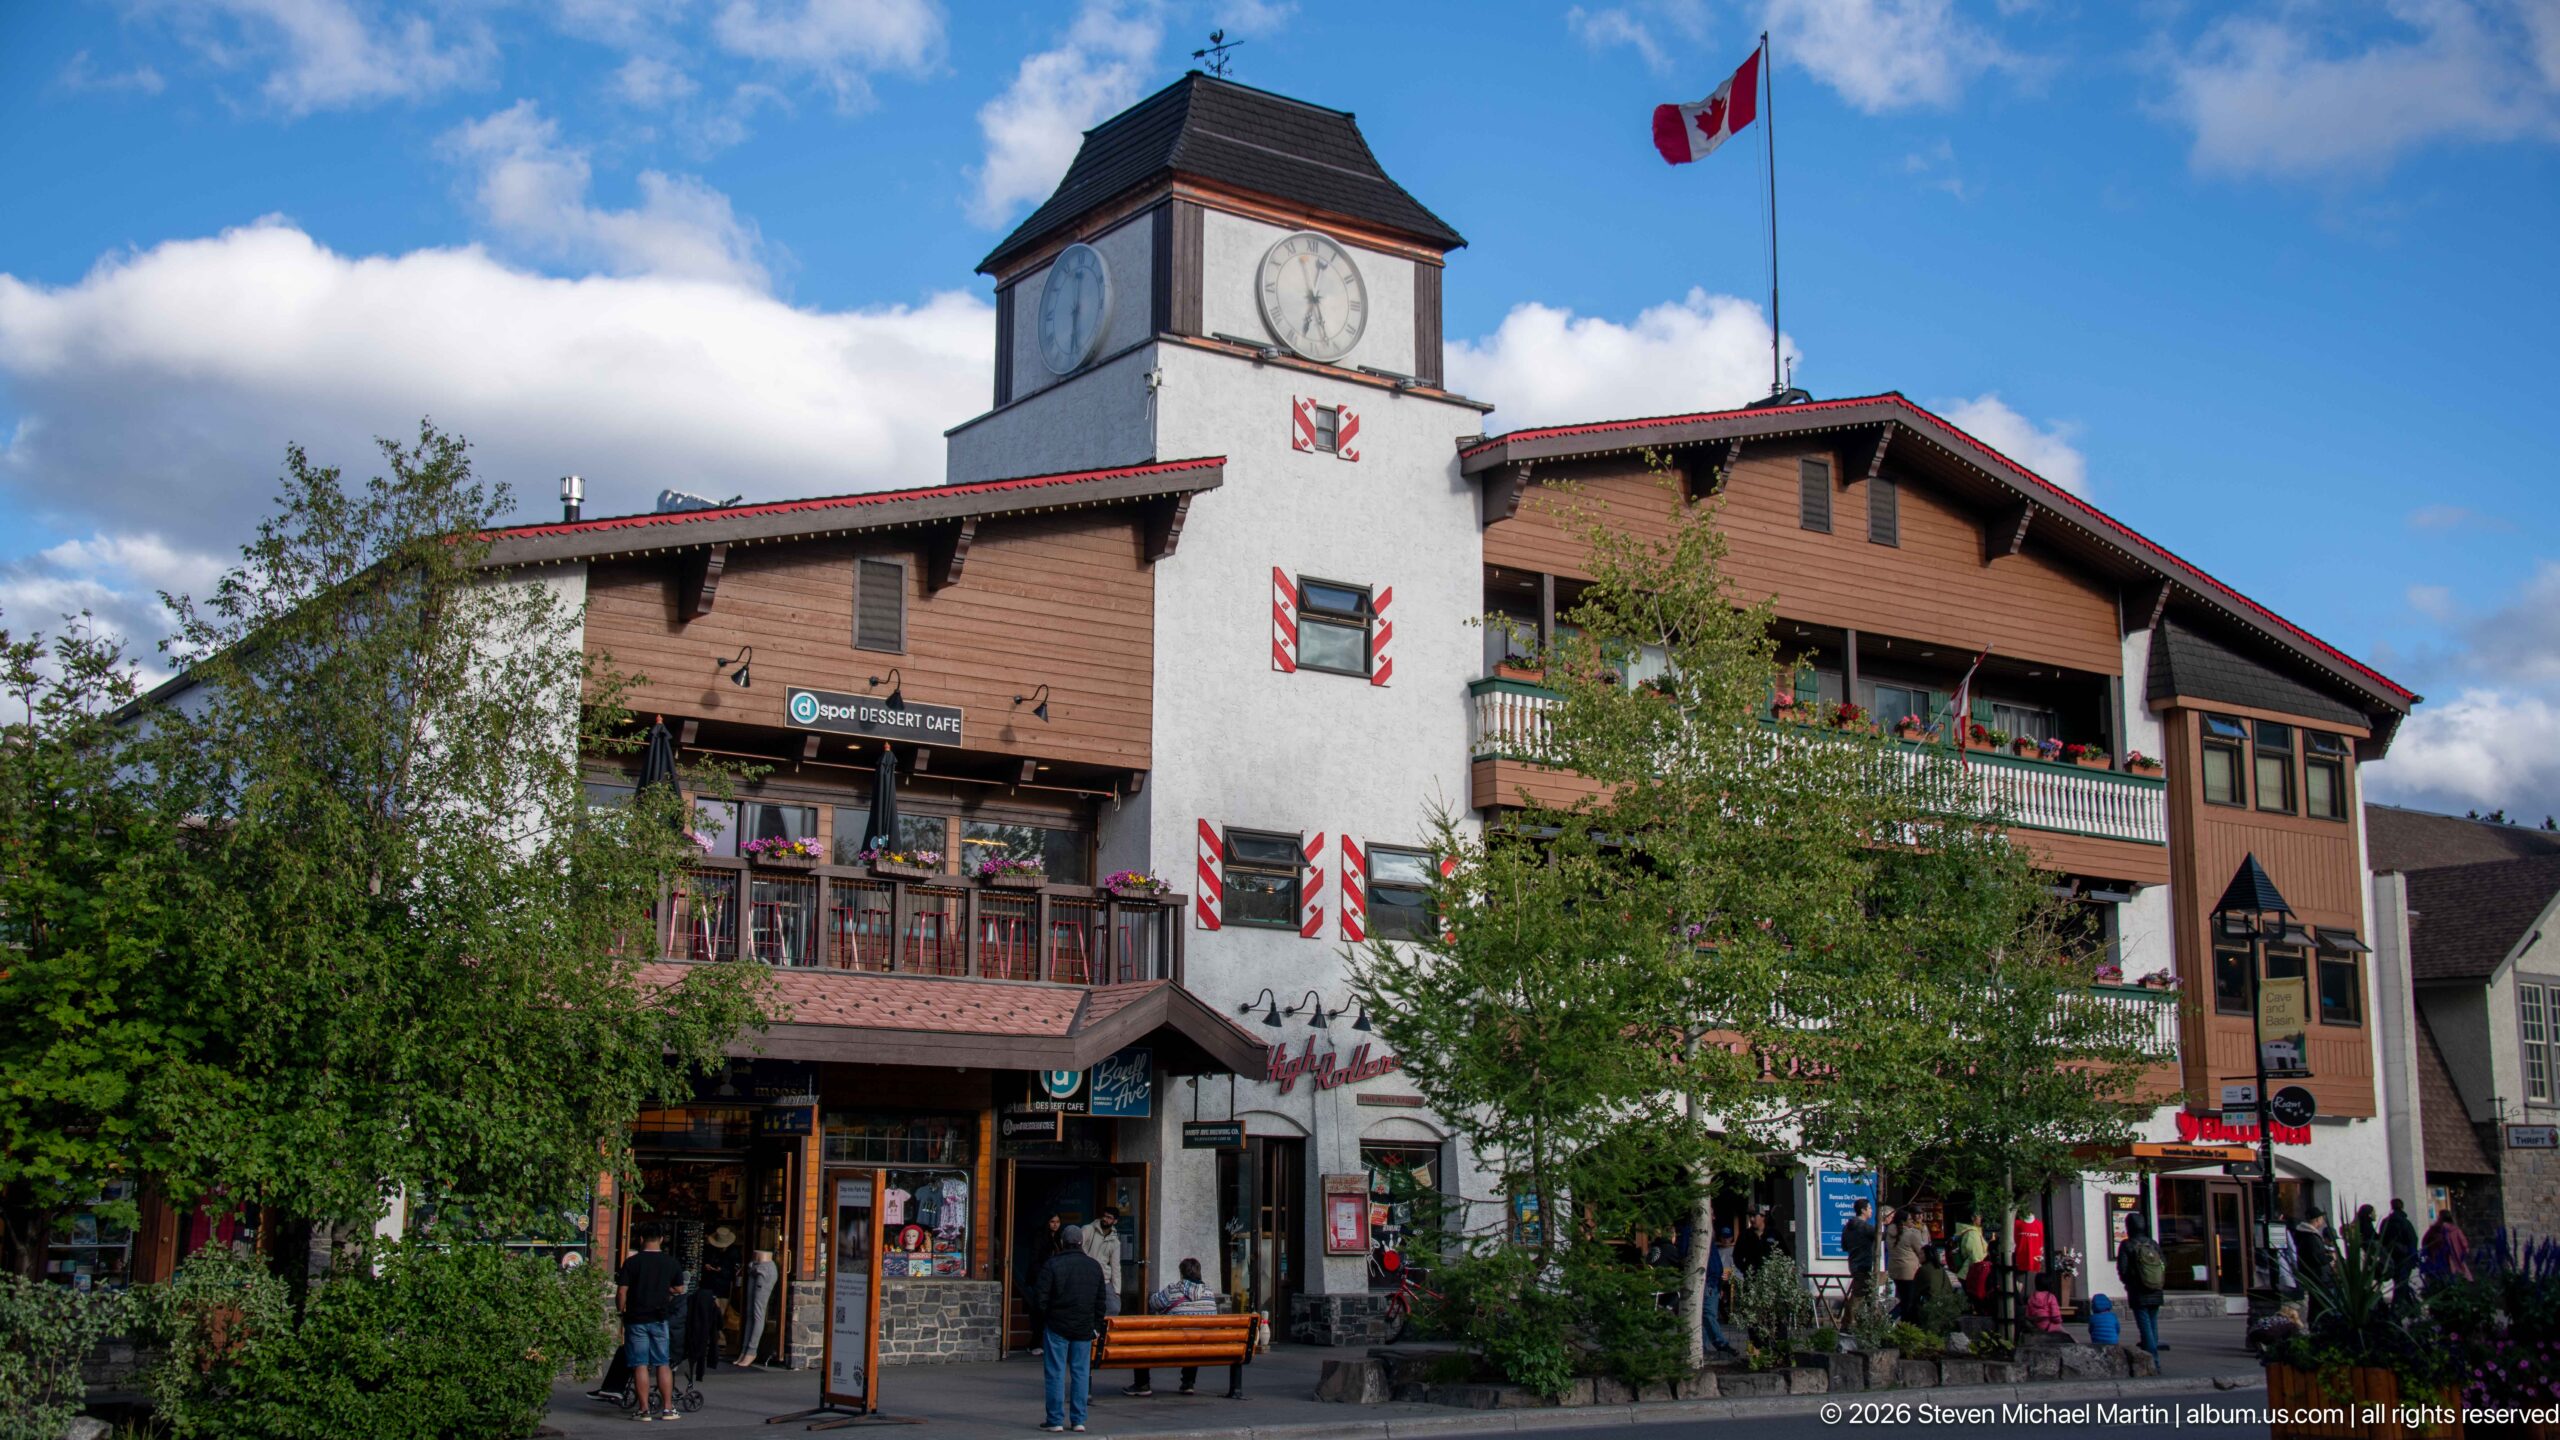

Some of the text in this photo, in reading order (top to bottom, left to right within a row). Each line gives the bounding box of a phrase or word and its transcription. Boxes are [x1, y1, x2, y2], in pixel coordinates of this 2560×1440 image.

[819, 704, 857, 721] spot
[859, 706, 923, 728] DESSERT
[926, 715, 961, 733] CAFE
[2265, 992, 2293, 1004] Cave
[2265, 1003, 2286, 1014] and
[2265, 1015, 2296, 1026] Basin
[1266, 1034, 1320, 1095] High
[1093, 1053, 1148, 1092] Banff
[1114, 1082, 1151, 1112] Ave
[1067, 1102, 1085, 1111] CAFE
[2515, 1136, 2545, 1145] THRIFT
[1822, 1175, 1847, 1184] Currency
